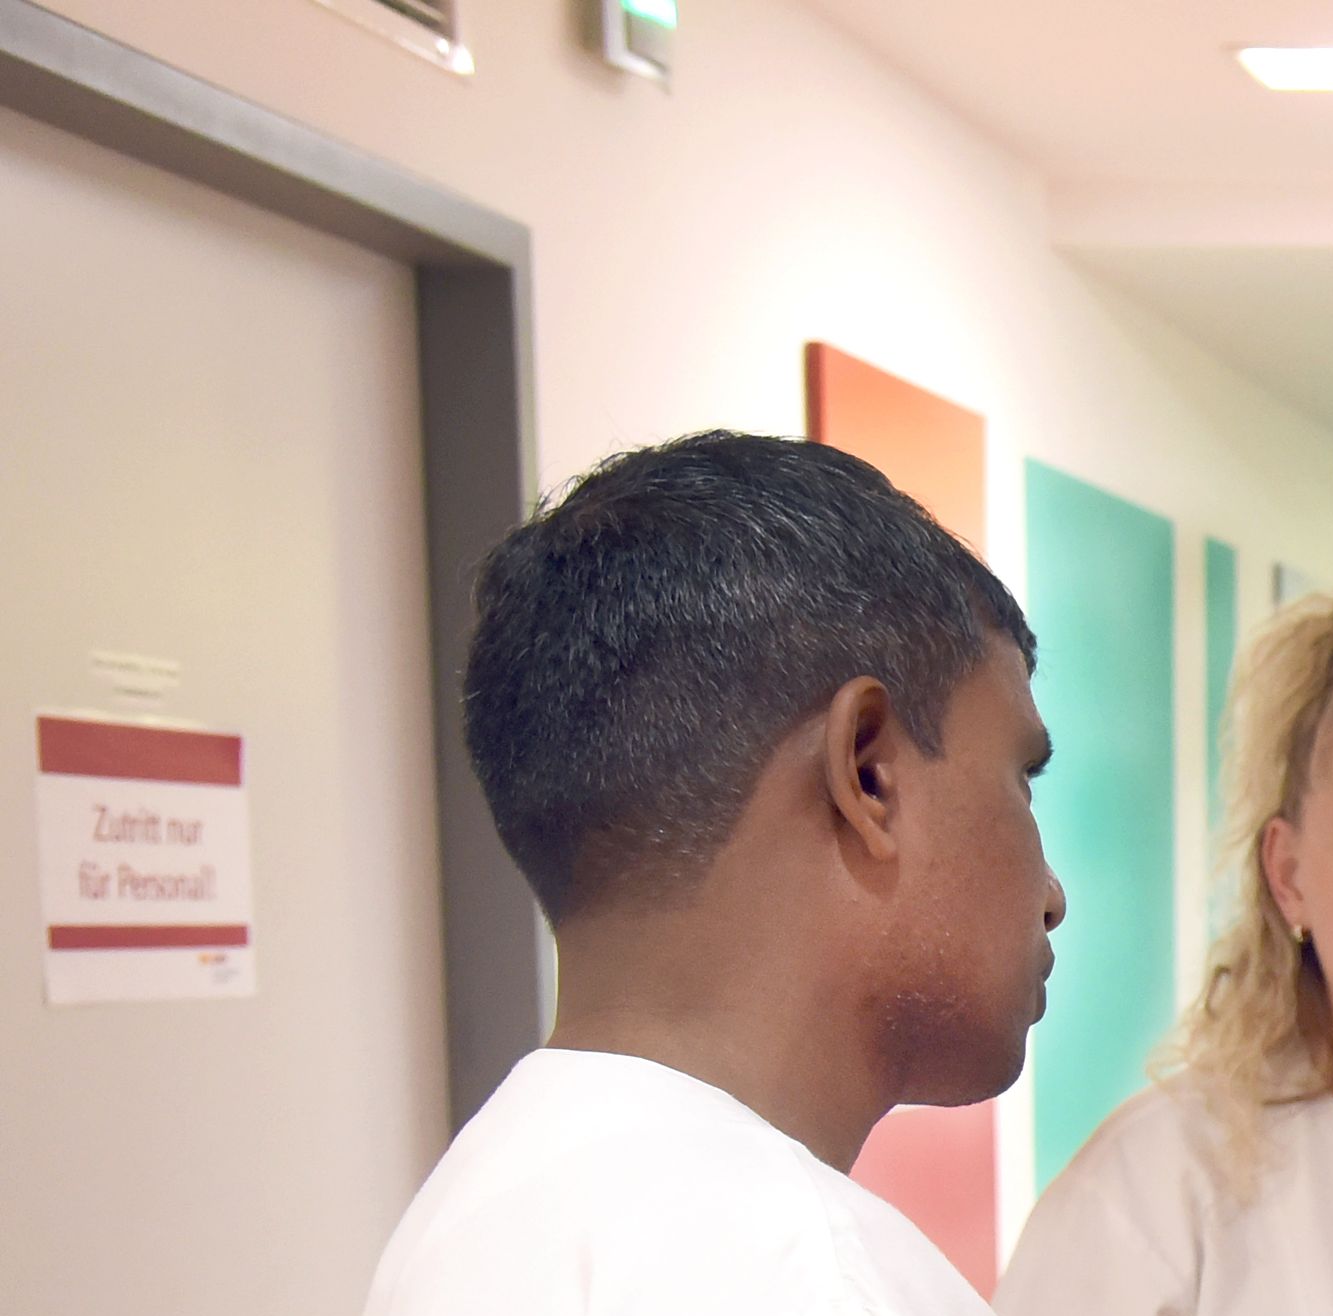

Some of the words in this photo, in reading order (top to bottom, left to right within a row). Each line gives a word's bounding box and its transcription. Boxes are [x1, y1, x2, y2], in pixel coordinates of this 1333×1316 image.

[92, 805, 162, 844] Zutritt
[166, 818, 203, 845] nur
[78, 860, 111, 900] für
